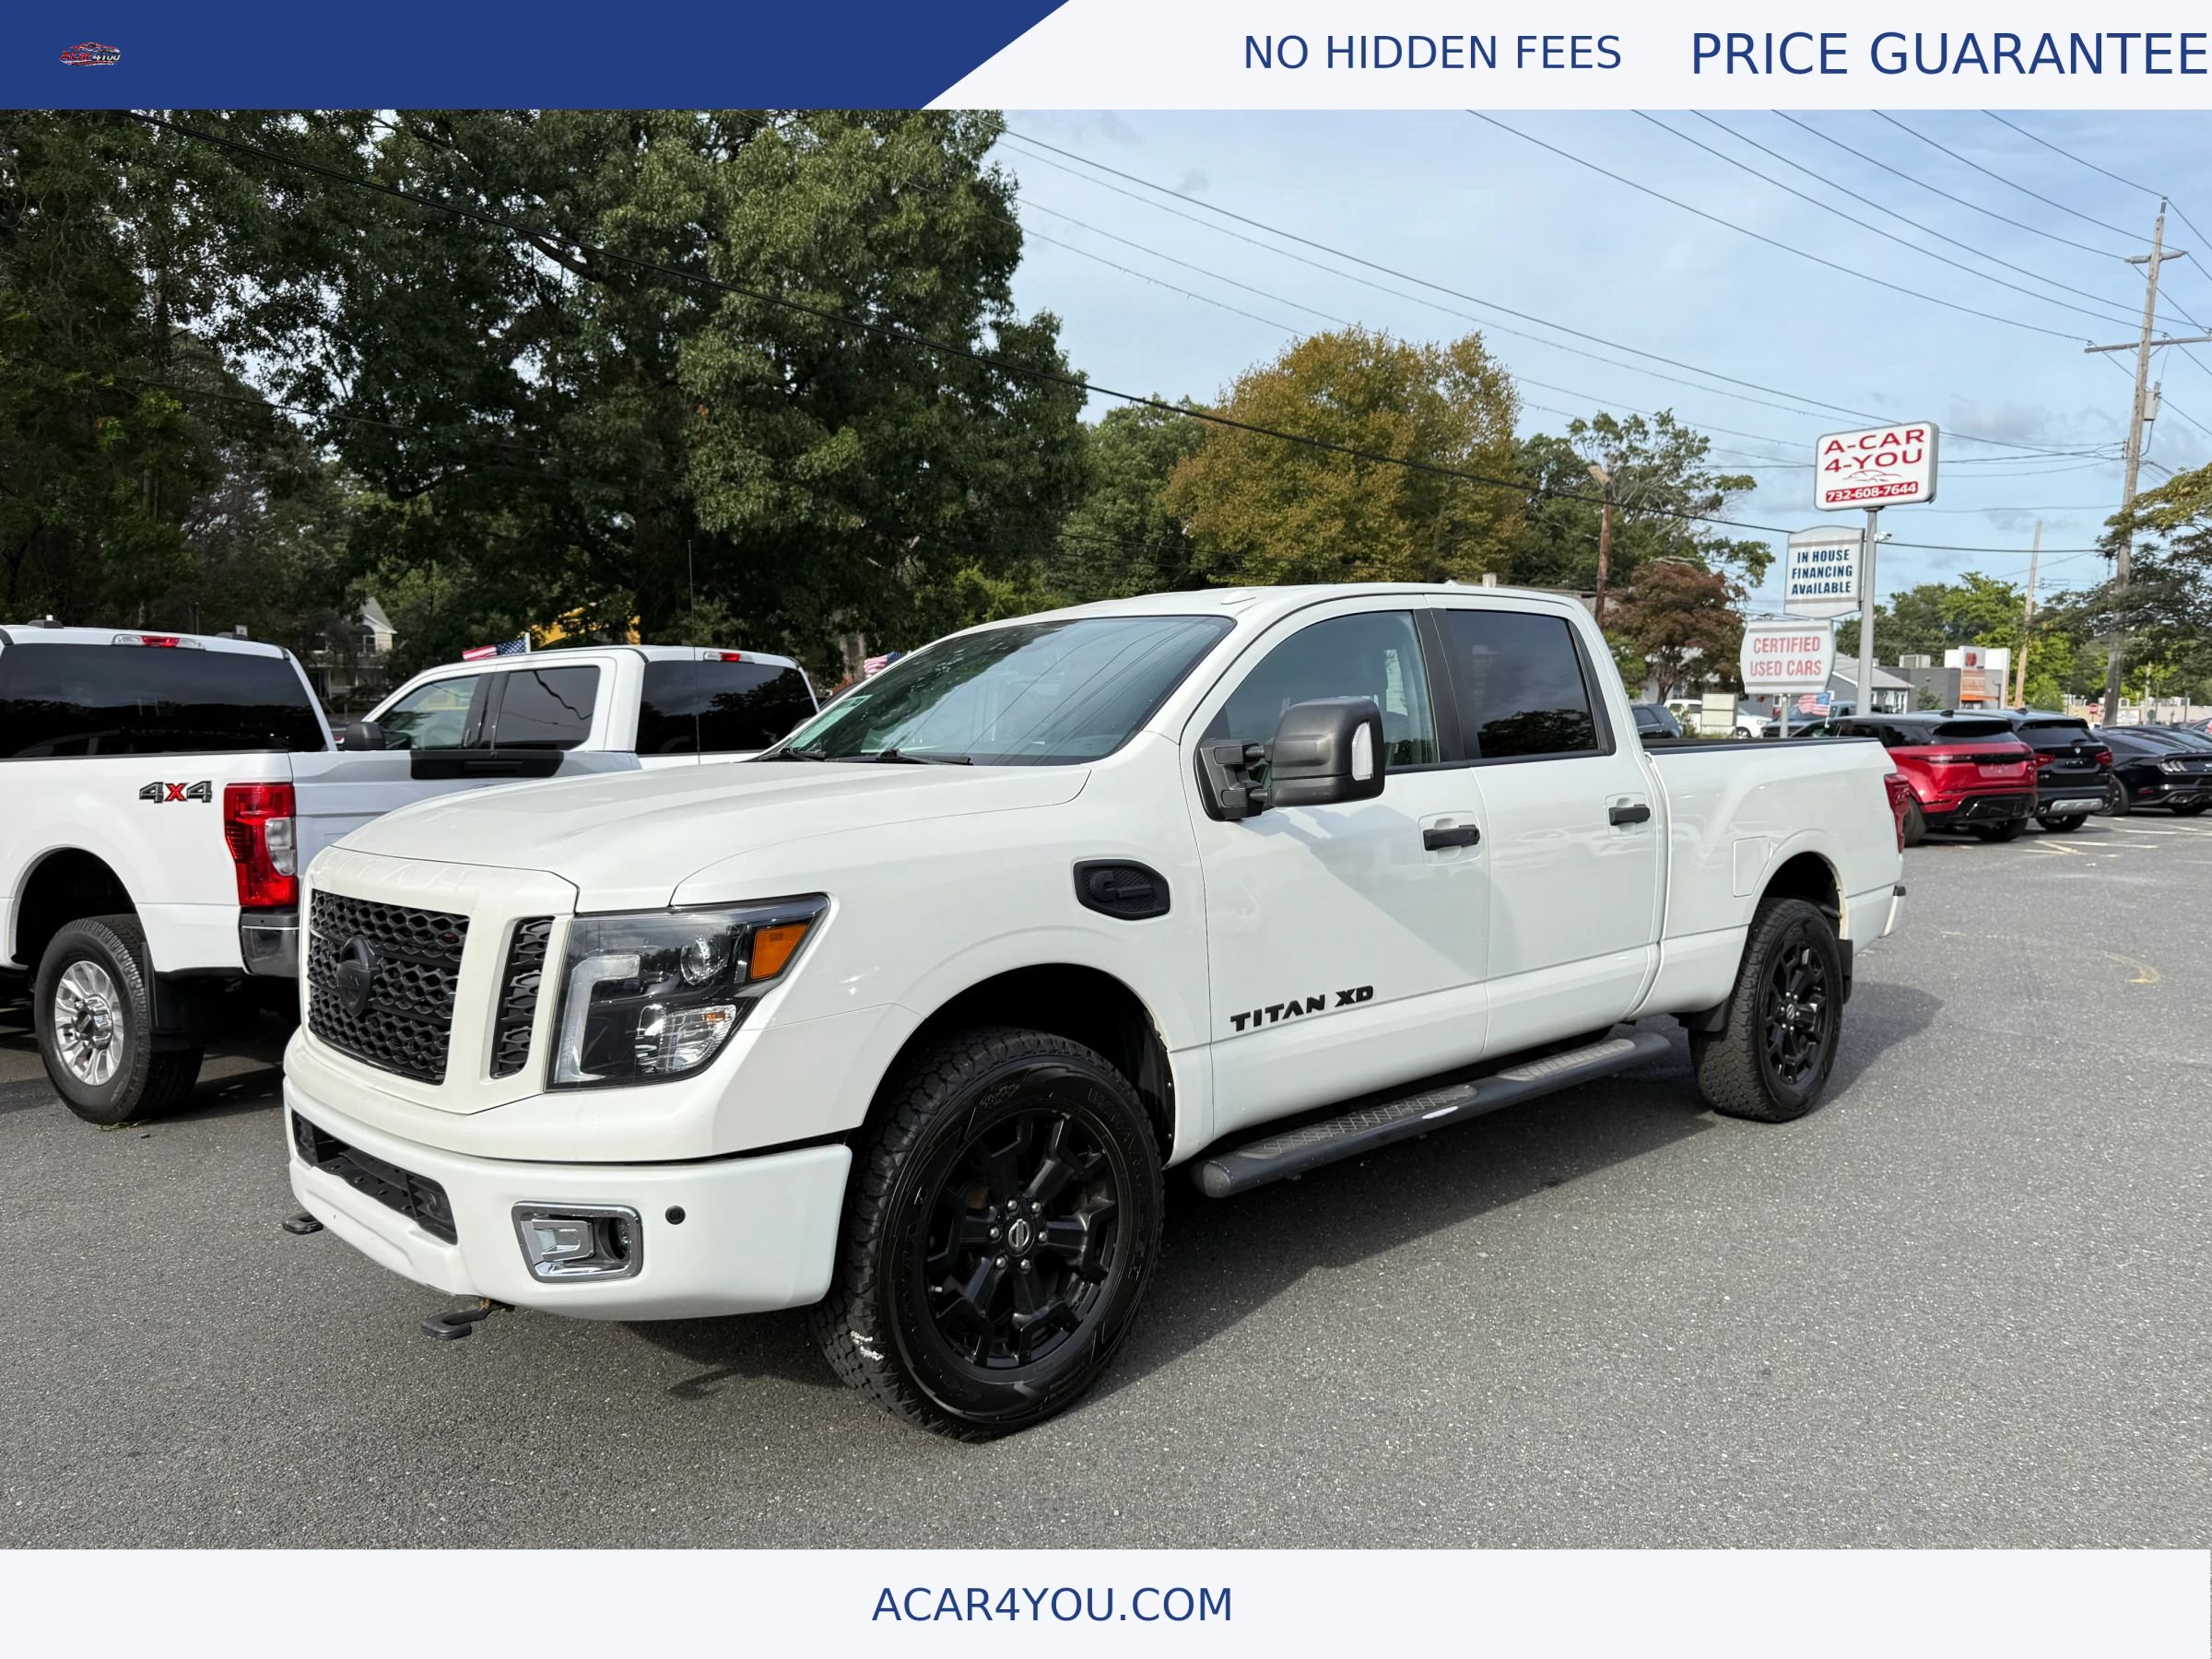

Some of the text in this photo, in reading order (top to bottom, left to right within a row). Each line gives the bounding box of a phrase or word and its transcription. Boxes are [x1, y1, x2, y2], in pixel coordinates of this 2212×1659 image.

[1824, 429, 1924, 455] A-CAR
[1824, 448, 1923, 473] 4-YOU
[1827, 482, 1917, 501] 732-608-7644
[1797, 548, 1850, 563] IN HOUSE
[1792, 565, 1853, 579] FINANCING
[1792, 581, 1852, 594] AVAILABLE
[1753, 636, 1820, 653] CERTIFIED
[1749, 659, 1822, 677] USED CARS
[1230, 985, 1374, 1032] TITAN XD
